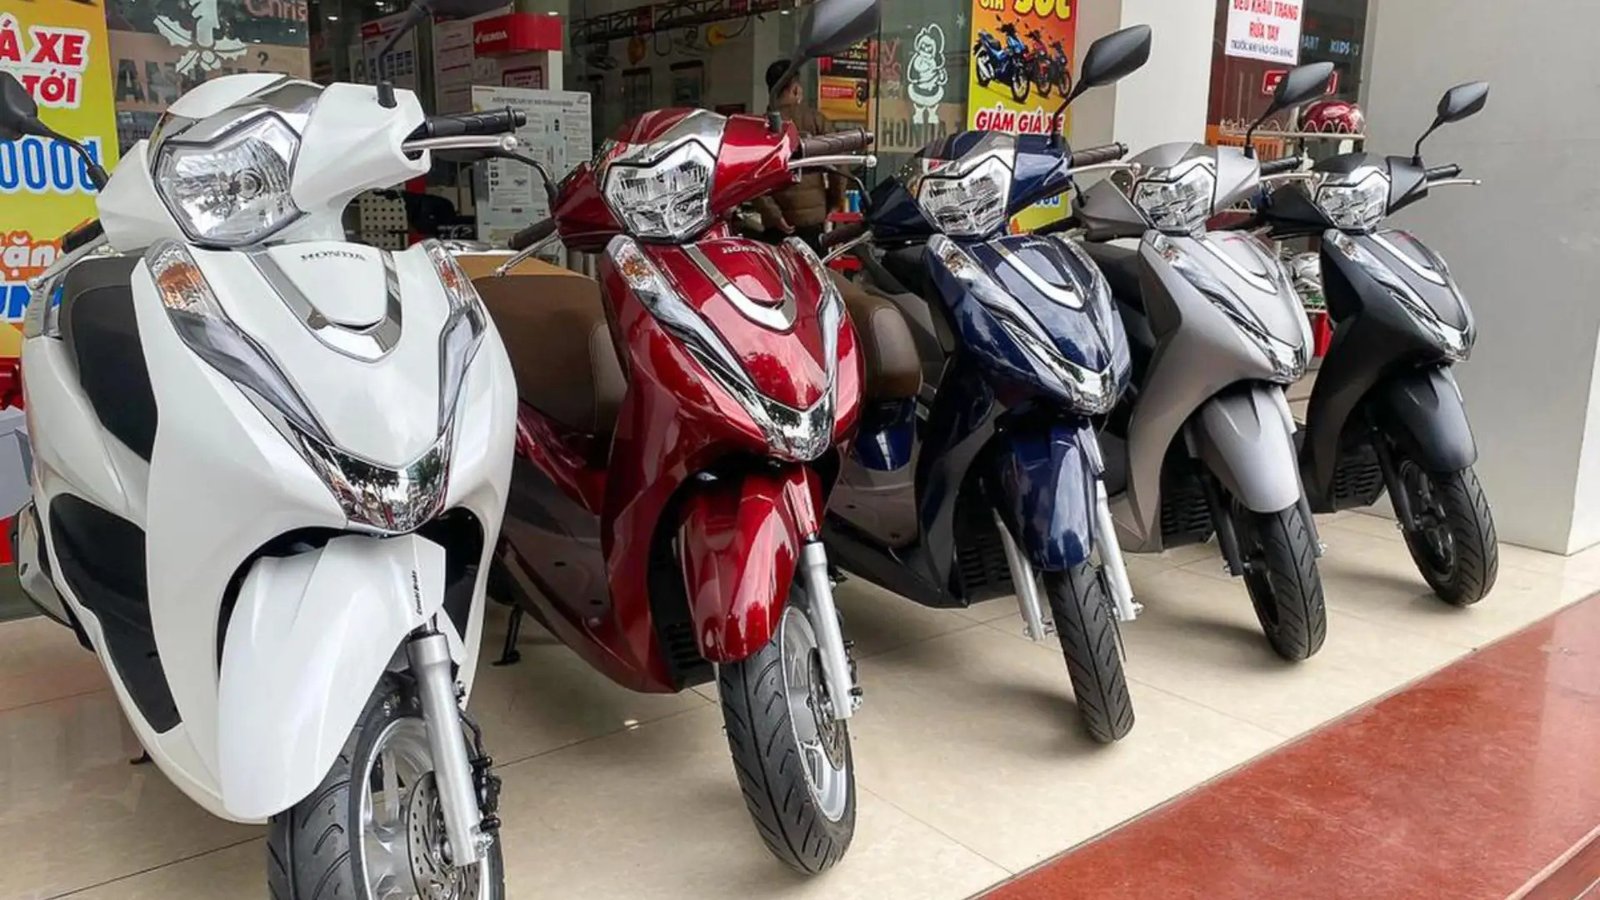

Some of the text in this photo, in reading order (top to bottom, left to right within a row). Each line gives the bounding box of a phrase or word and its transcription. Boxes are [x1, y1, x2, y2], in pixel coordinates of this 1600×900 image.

[32, 31, 84, 66] XE
[22, 68, 77, 103] TỚI
[976, 104, 1015, 131] GIẢM
[1018, 109, 1043, 133] GIÁ
[0, 235, 61, 275] ặn
[301, 250, 366, 261] HONDA
